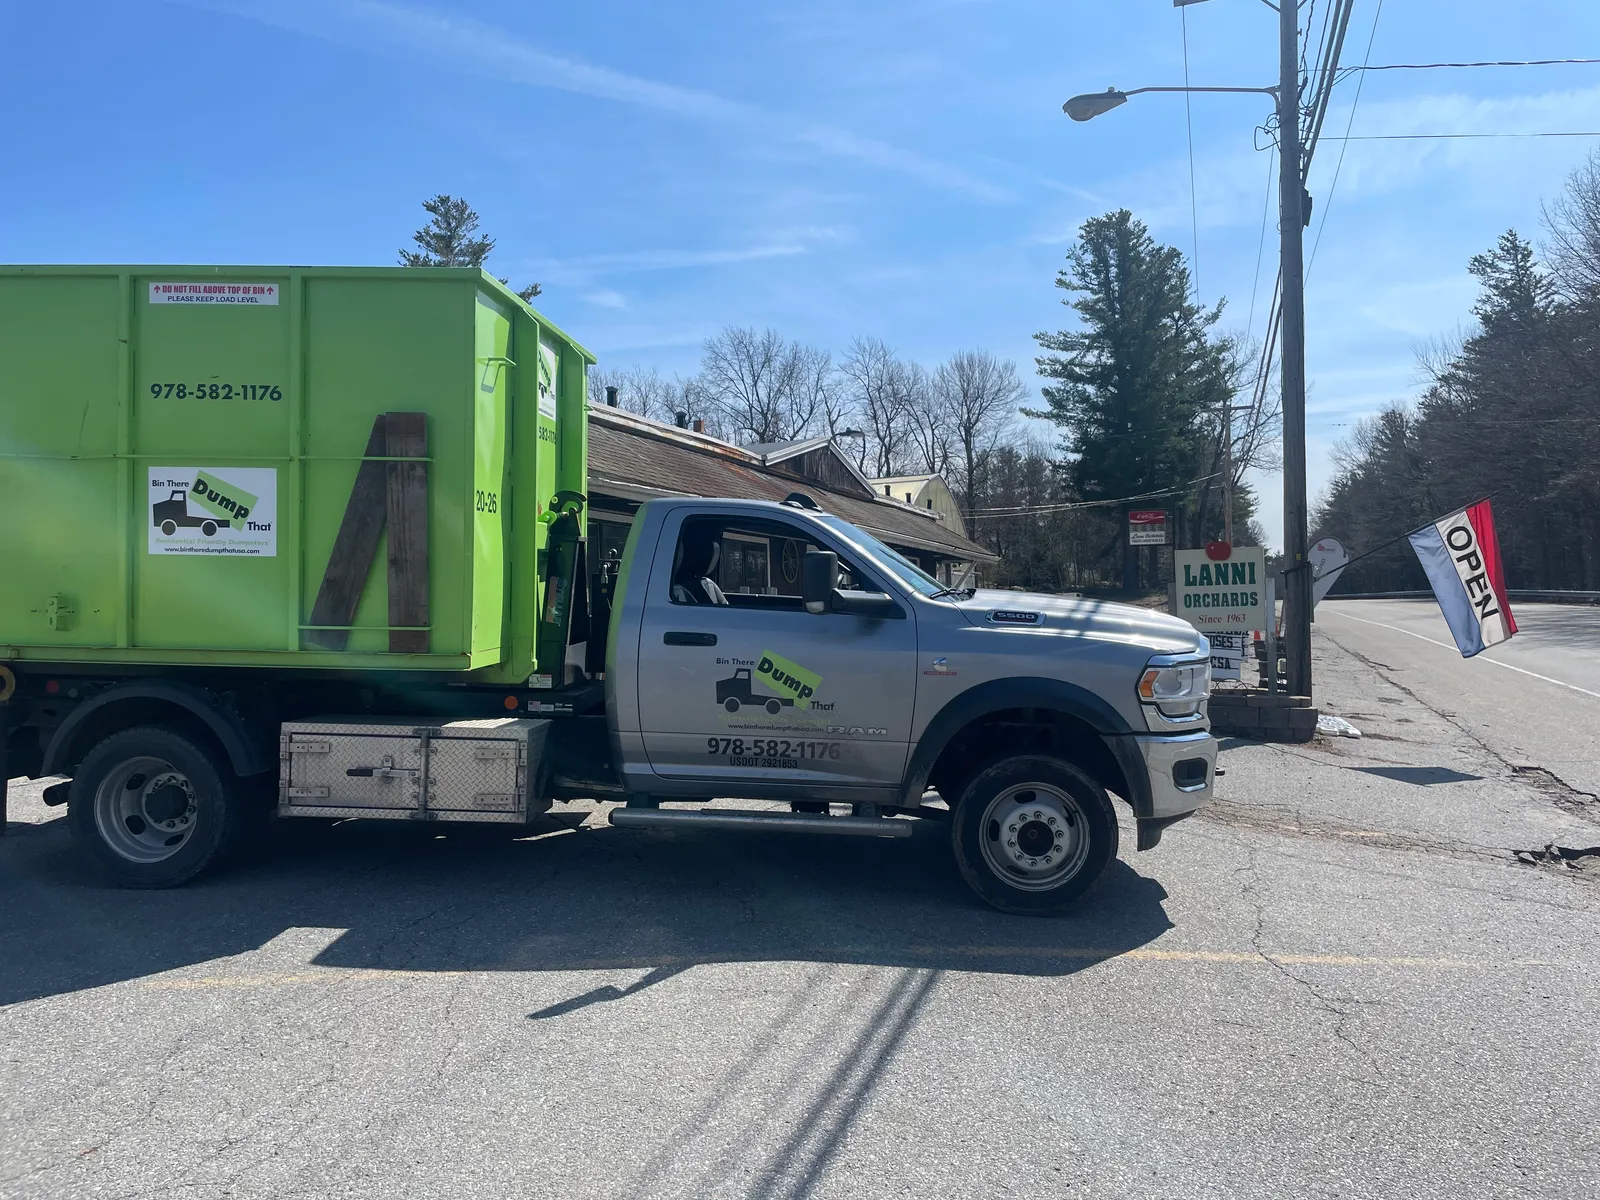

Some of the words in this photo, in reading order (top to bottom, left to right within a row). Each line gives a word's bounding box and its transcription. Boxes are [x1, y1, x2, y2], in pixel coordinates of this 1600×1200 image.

[162, 285, 172, 293] DO
[173, 285, 188, 293] NOT
[188, 285, 202, 294] FILL
[203, 285, 226, 294] ABOVE
[227, 285, 241, 294] TOP
[242, 286, 251, 294] OF
[252, 286, 265, 295] BIN
[150, 383, 282, 401] 978-582-1176
[192, 478, 250, 520] Dump
[476, 490, 497, 514] 20-26
[246, 521, 271, 532] That
[164, 546, 260, 554] www.bintheredumpthatusa.com
[1183, 562, 1257, 586] LANNI
[1446, 525, 1500, 620] OPEN
[1183, 591, 1259, 608] ORCHARDS
[1198, 614, 1223, 624] Since
[1226, 613, 1246, 623] 1963
[716, 657, 729, 665] Bin
[732, 658, 755, 666] There
[756, 656, 814, 700] Dump
[810, 700, 835, 711] That
[827, 725, 888, 736] RAM
[707, 737, 840, 760] 978-582-1176
[730, 756, 759, 767] USDOT
[761, 758, 798, 768] 2921853
